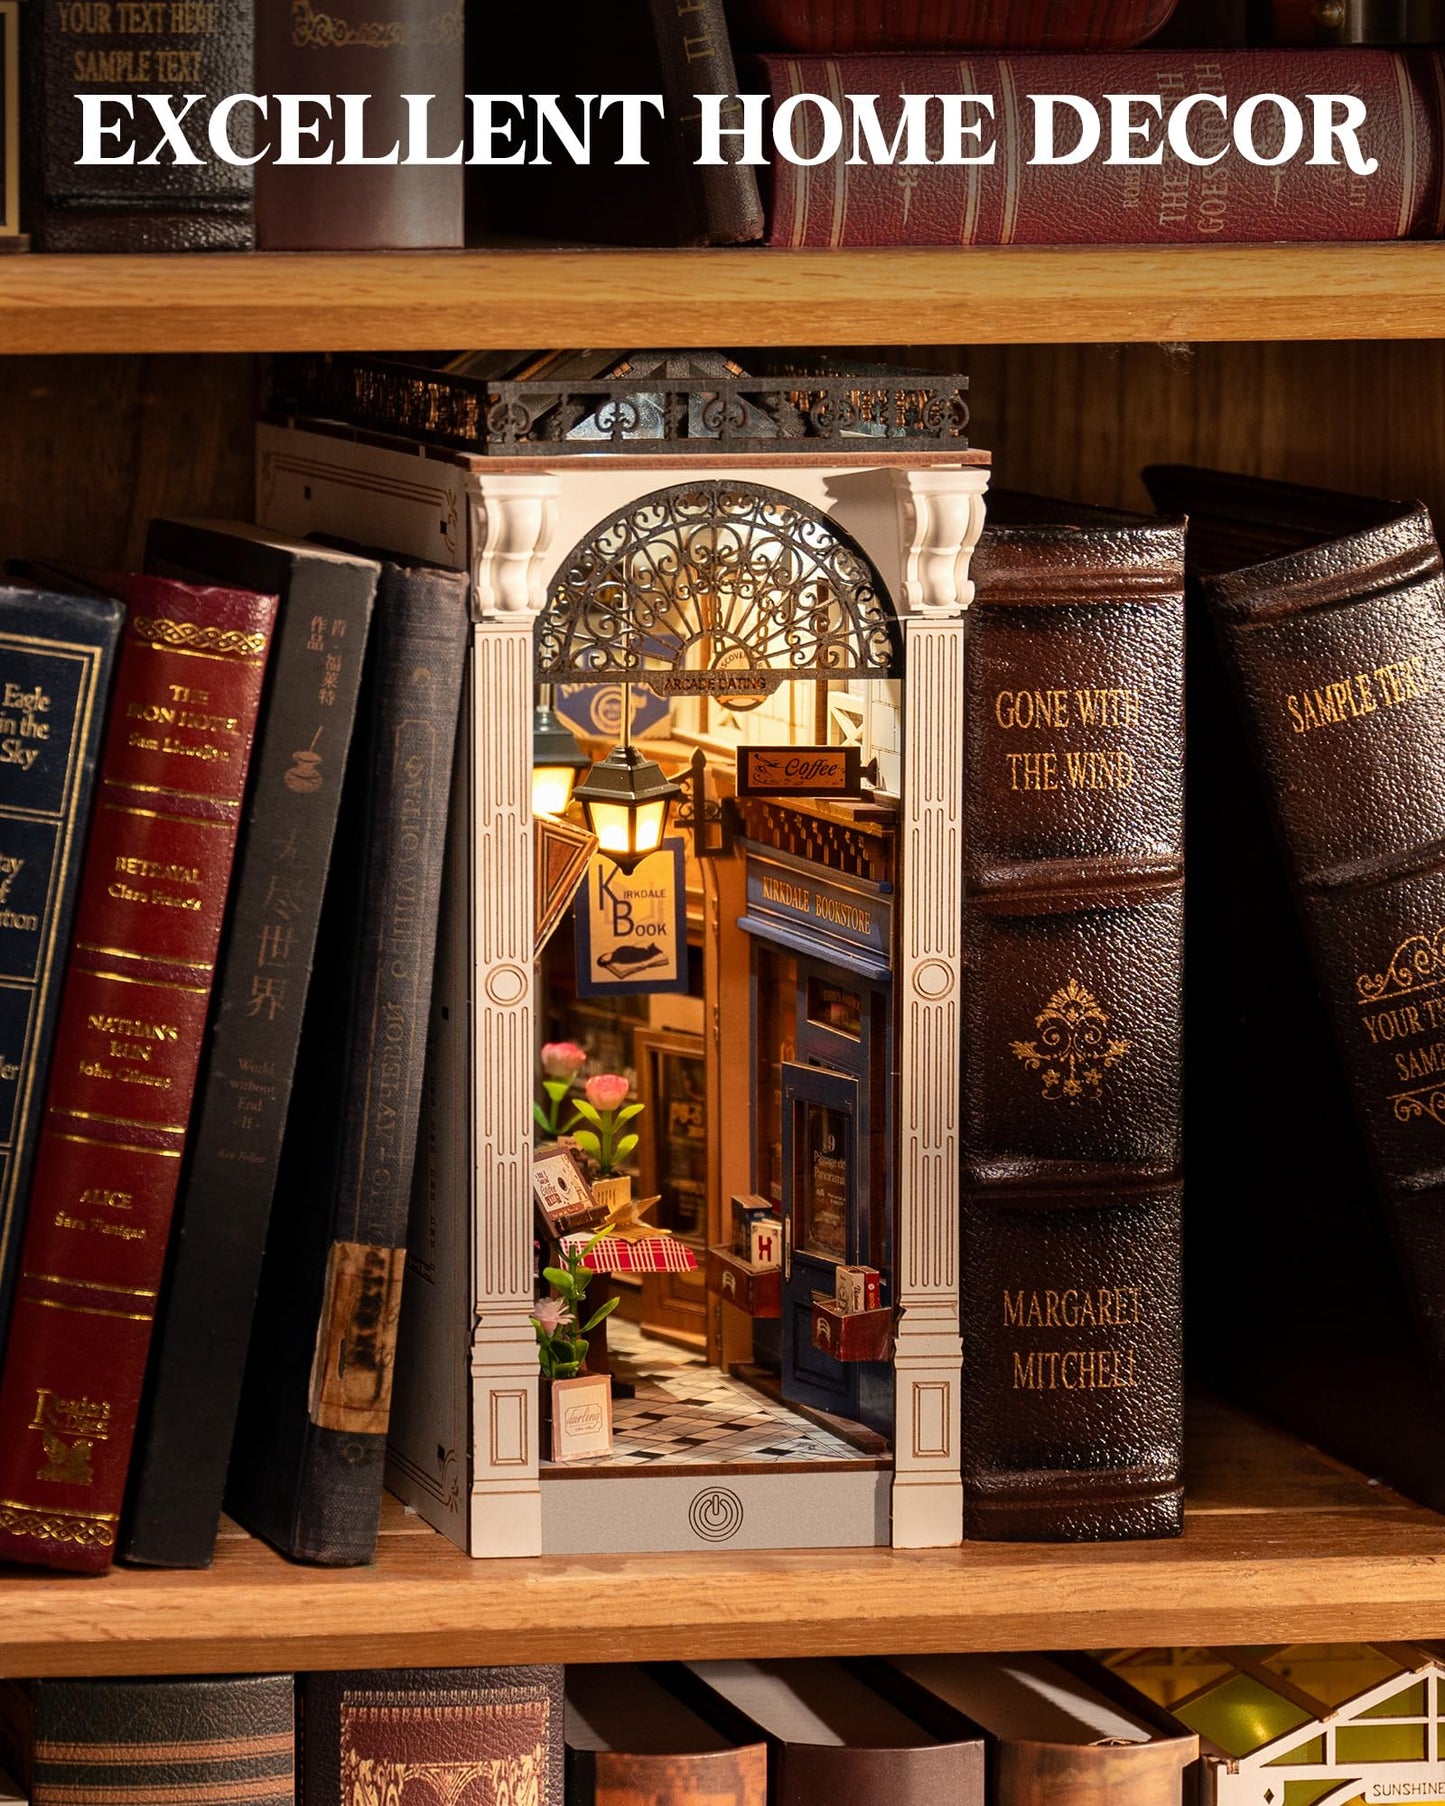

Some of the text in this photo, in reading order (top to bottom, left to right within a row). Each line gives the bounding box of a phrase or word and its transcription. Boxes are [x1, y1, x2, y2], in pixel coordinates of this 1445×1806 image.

[58, 2, 219, 34] YOUR TEXT HERE
[73, 51, 202, 83] SAMPLE TEXT
[1158, 171, 1189, 226] THE
[1197, 166, 1230, 233] GOES
[2, 682, 51, 713] Eagle
[664, 677, 716, 691] ARCADE
[719, 677, 767, 690] DATING
[1286, 655, 1430, 734] SAMPLE TEXT
[20, 714, 50, 740] the
[995, 688, 1140, 730] GONE WITH
[0, 739, 39, 771] Sky
[785, 758, 838, 780] Coffee
[1006, 751, 1134, 791] THE WIND
[762, 875, 872, 935] KIRKDALE BOOKSTORE
[1361, 1005, 1425, 1044] YOUR
[1002, 1287, 1142, 1329] MARGARET
[1012, 1349, 1140, 1391] MITCHELL
[1372, 1781, 1445, 1797] SUNSHINE
